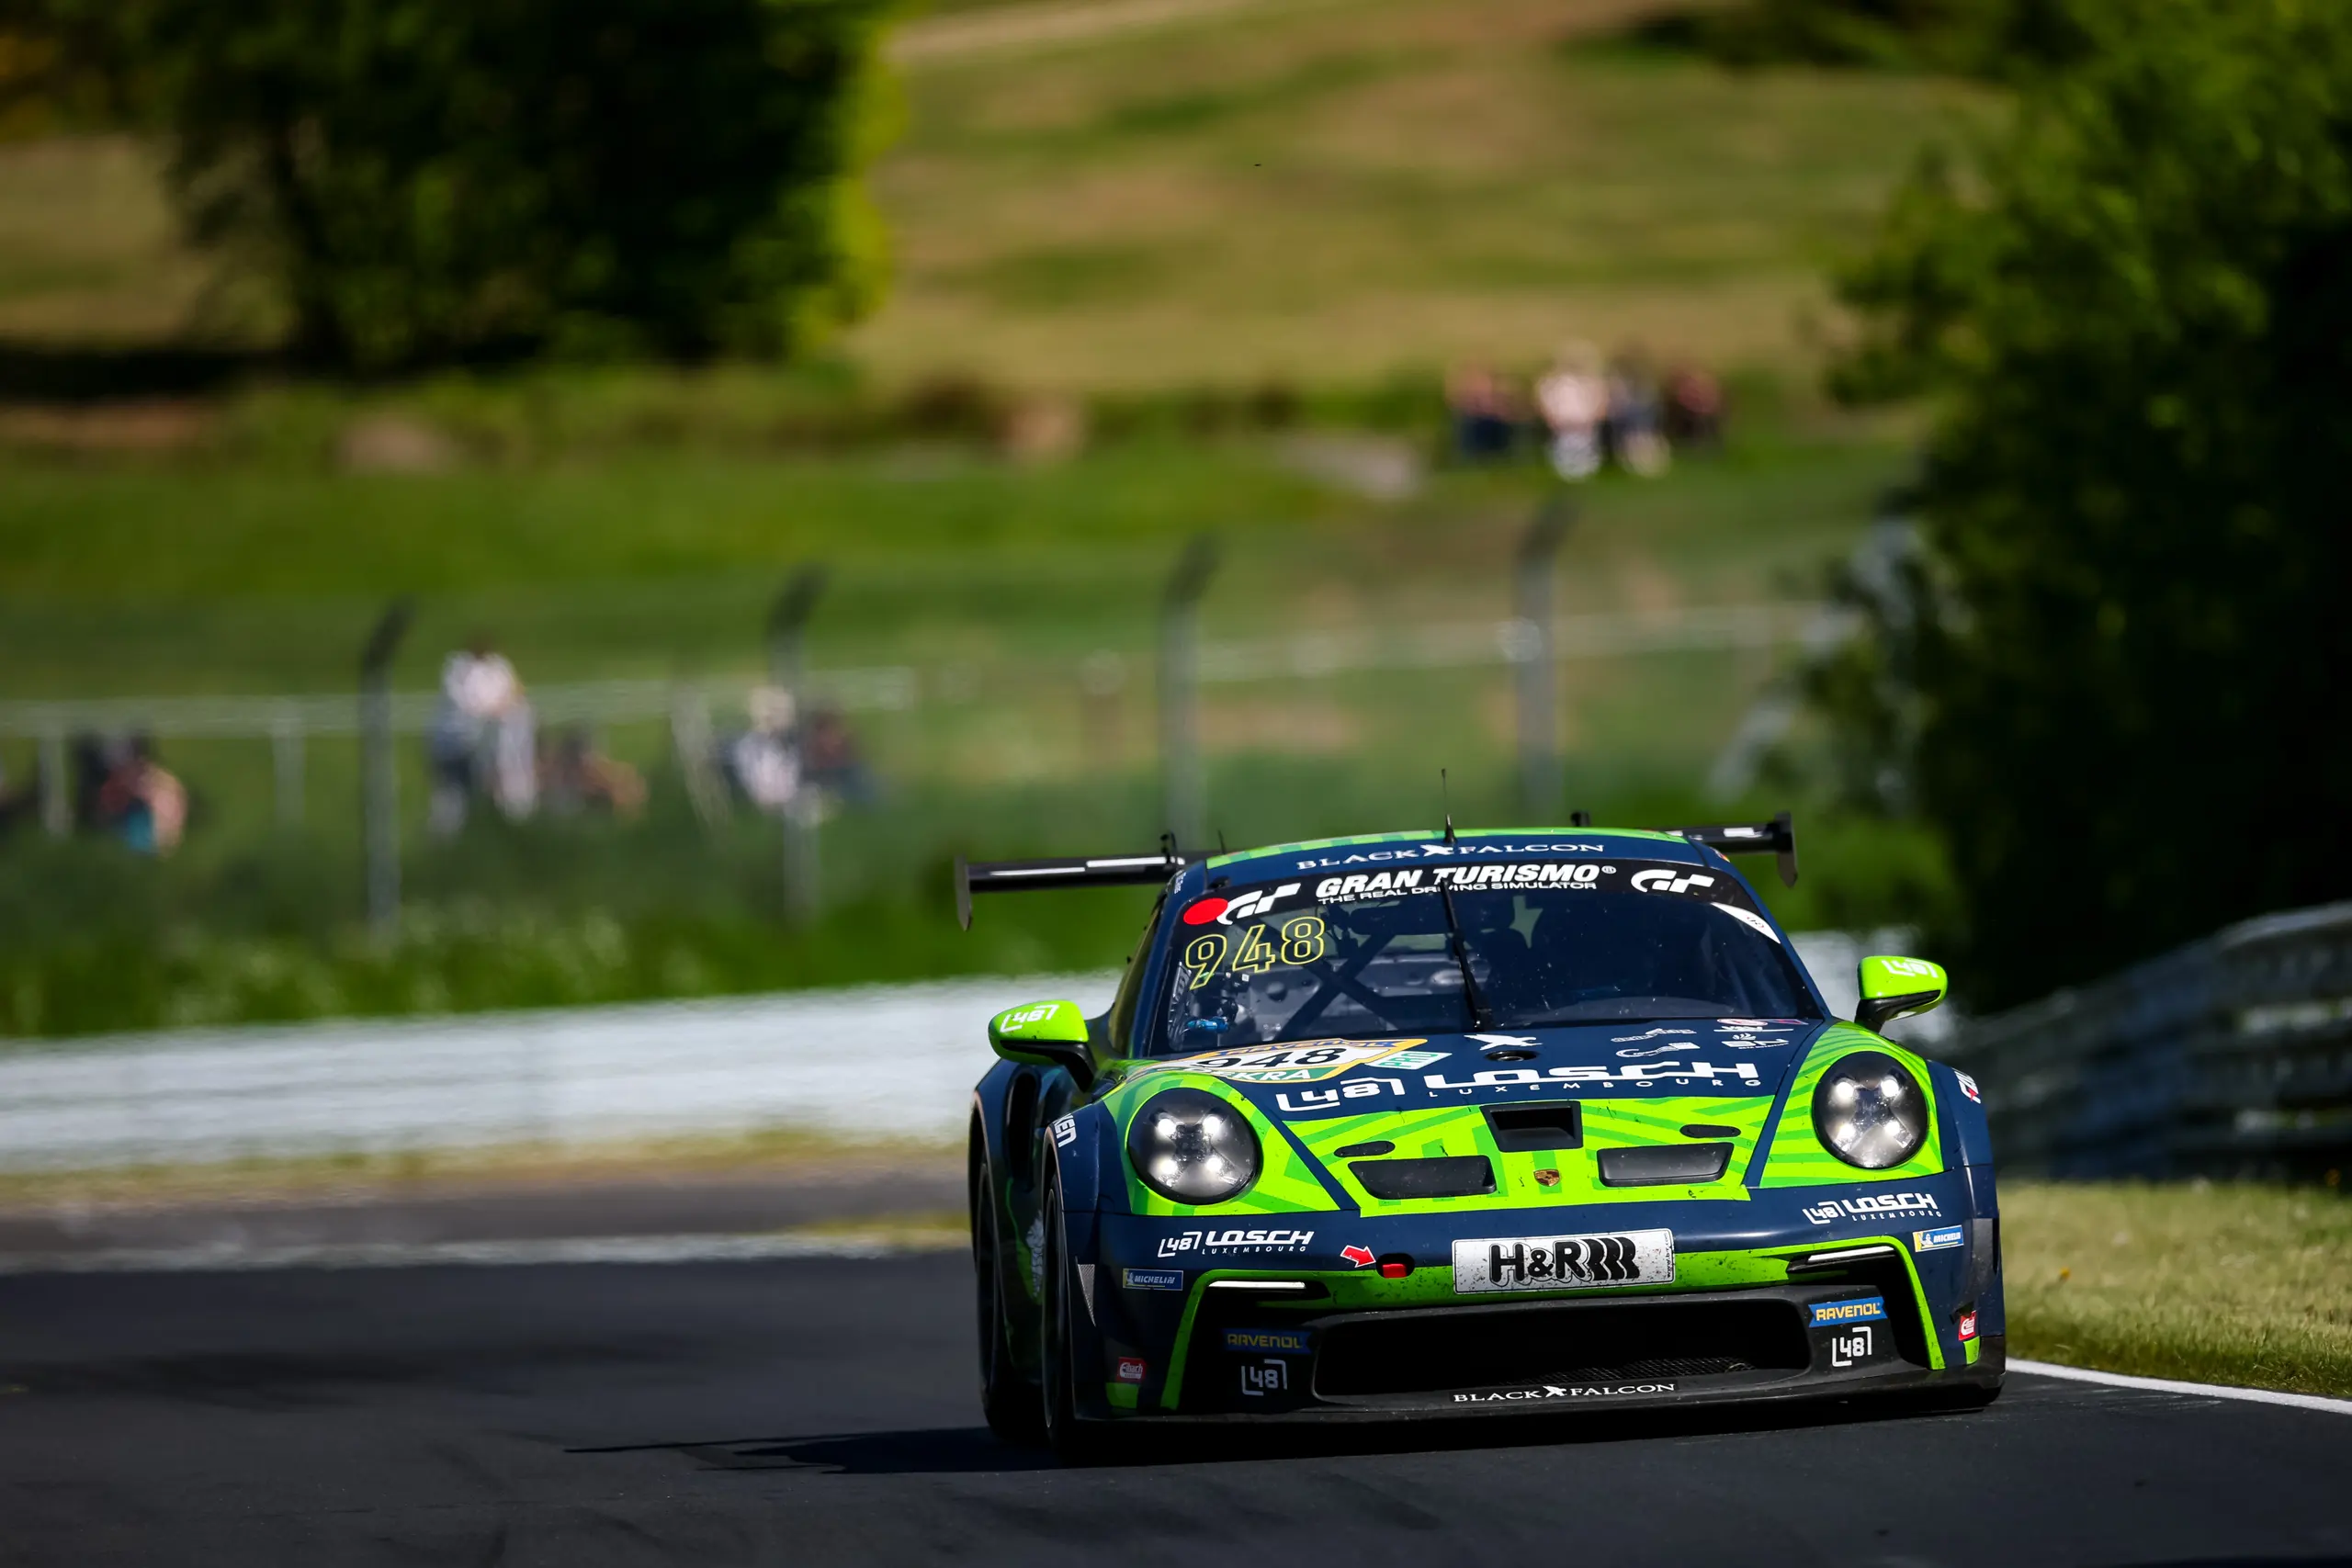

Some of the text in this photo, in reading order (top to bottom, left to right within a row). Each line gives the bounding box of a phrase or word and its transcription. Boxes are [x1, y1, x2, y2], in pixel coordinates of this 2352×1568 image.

[1296, 844, 1604, 870] BLACK FALCON
[1316, 869, 1423, 898] GRAN
[1317, 894, 1356, 905] THE
[1360, 889, 1408, 900] REAL
[1491, 882, 1597, 890] SIMULATOR
[1185, 916, 1325, 990] 948
[1191, 1047, 1348, 1068] 948
[1379, 1051, 1439, 1068] PRO
[1424, 1061, 1758, 1089] LOSCH
[1429, 1077, 1761, 1098] LUXEMBOURG
[1841, 1192, 1939, 1213] LOSCH
[1851, 1210, 1942, 1221] LUXEMBOURG
[1205, 1230, 1315, 1247] LOSCH
[1202, 1246, 1306, 1255] LUXEMBOURG
[1489, 1239, 1592, 1285] H&R
[1134, 1274, 1176, 1284] MICHELIN
[1816, 1303, 1881, 1321] RAVENOL
[1227, 1334, 1303, 1348] RAVENOL
[1453, 1382, 1676, 1403] BLACK FALCON
